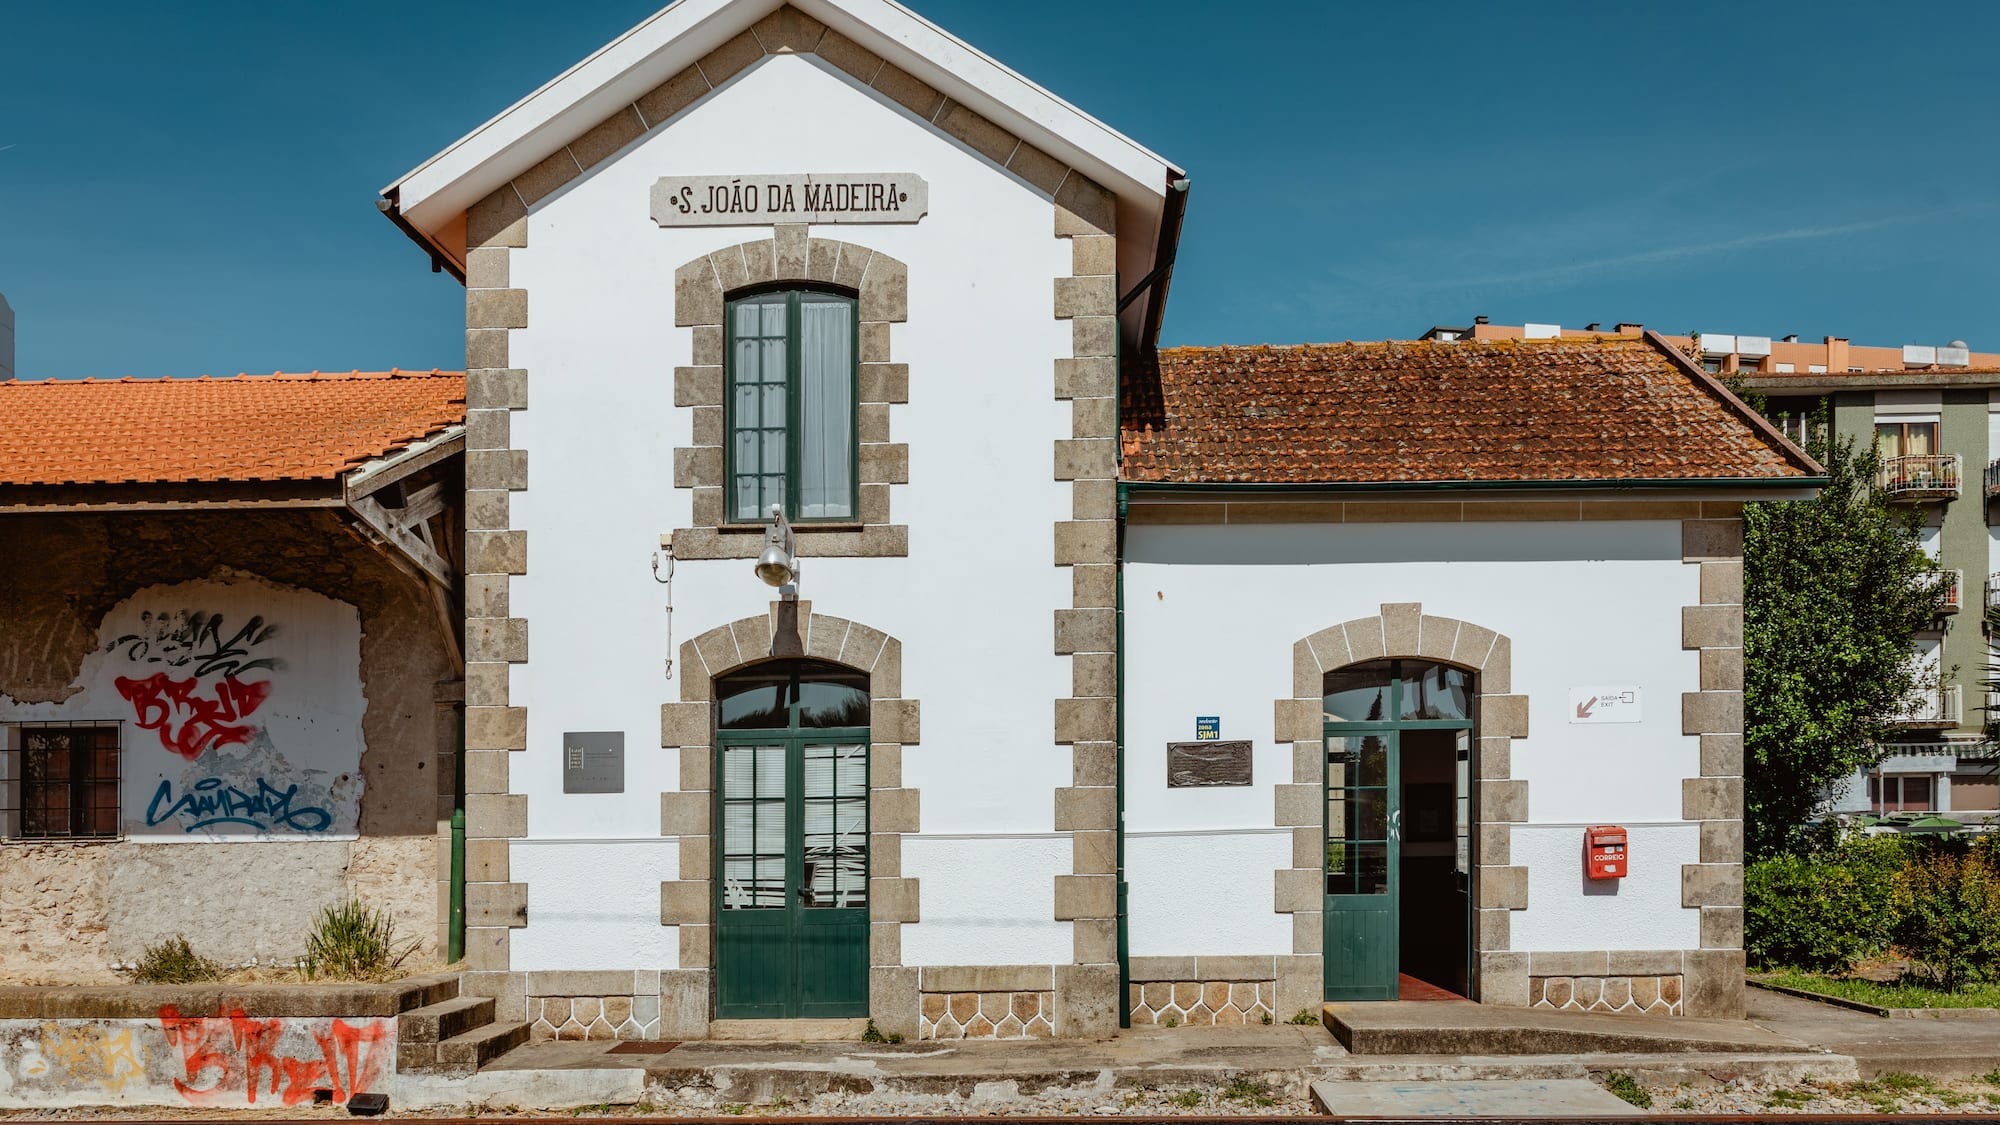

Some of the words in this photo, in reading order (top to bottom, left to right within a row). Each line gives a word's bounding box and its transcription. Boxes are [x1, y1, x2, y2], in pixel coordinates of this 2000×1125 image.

[679, 186, 698, 214] S.
[701, 178, 758, 213] JOÃO
[767, 184, 796, 213] DA
[803, 183, 900, 212] MADEIRA
[1594, 854, 1625, 862] CORREIO
